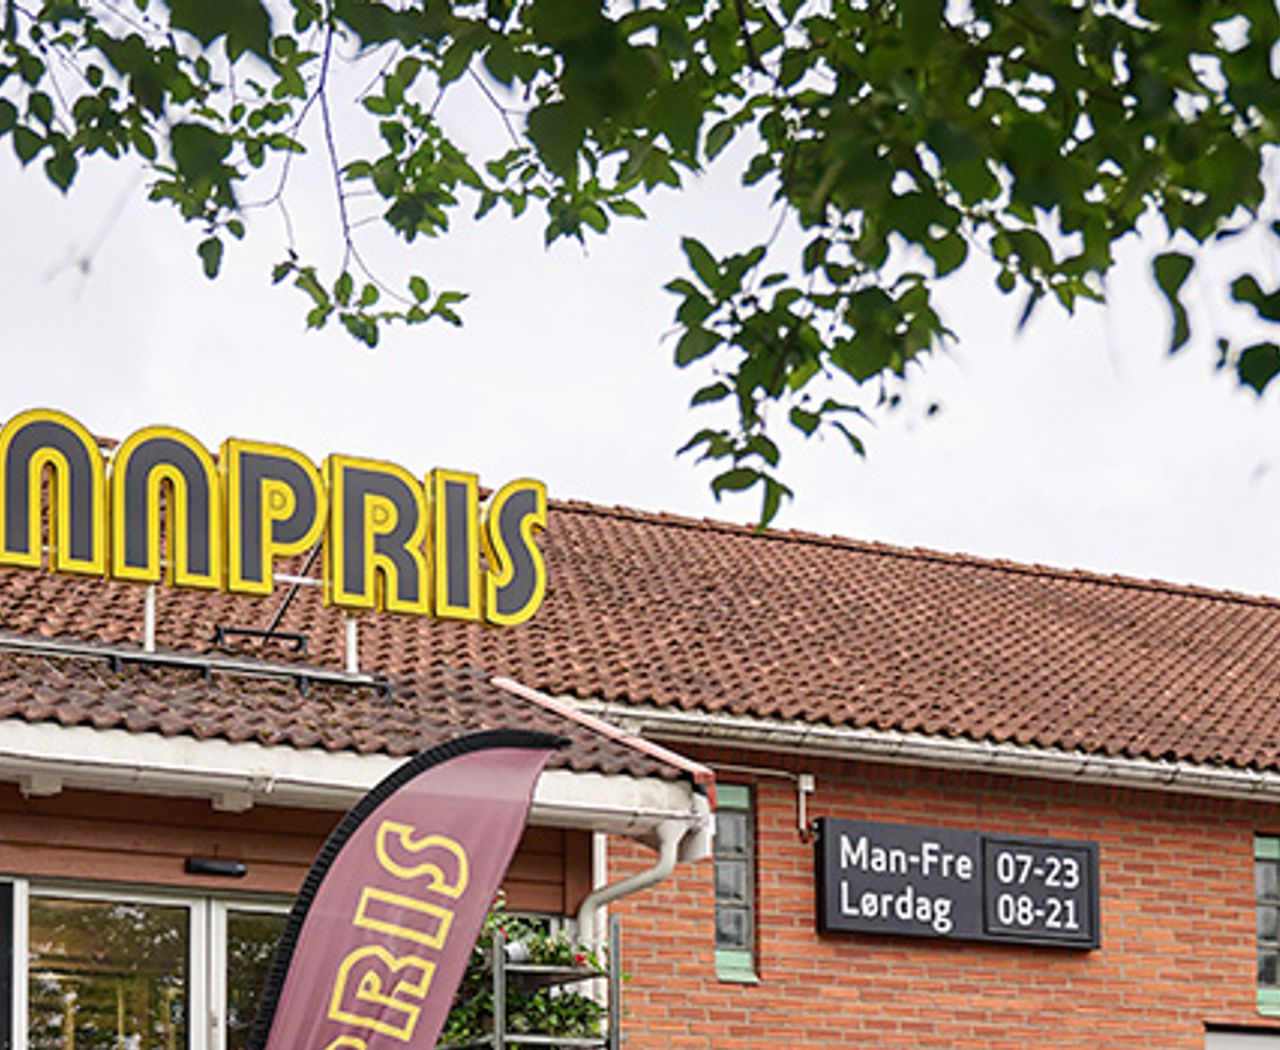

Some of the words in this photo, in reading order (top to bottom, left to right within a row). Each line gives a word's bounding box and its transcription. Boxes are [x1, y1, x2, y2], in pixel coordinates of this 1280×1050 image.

[839, 834, 972, 879] Man-Fre
[996, 852, 1079, 889] 07-23
[840, 881, 952, 933] Lørdag
[997, 894, 1079, 929] 08-21
